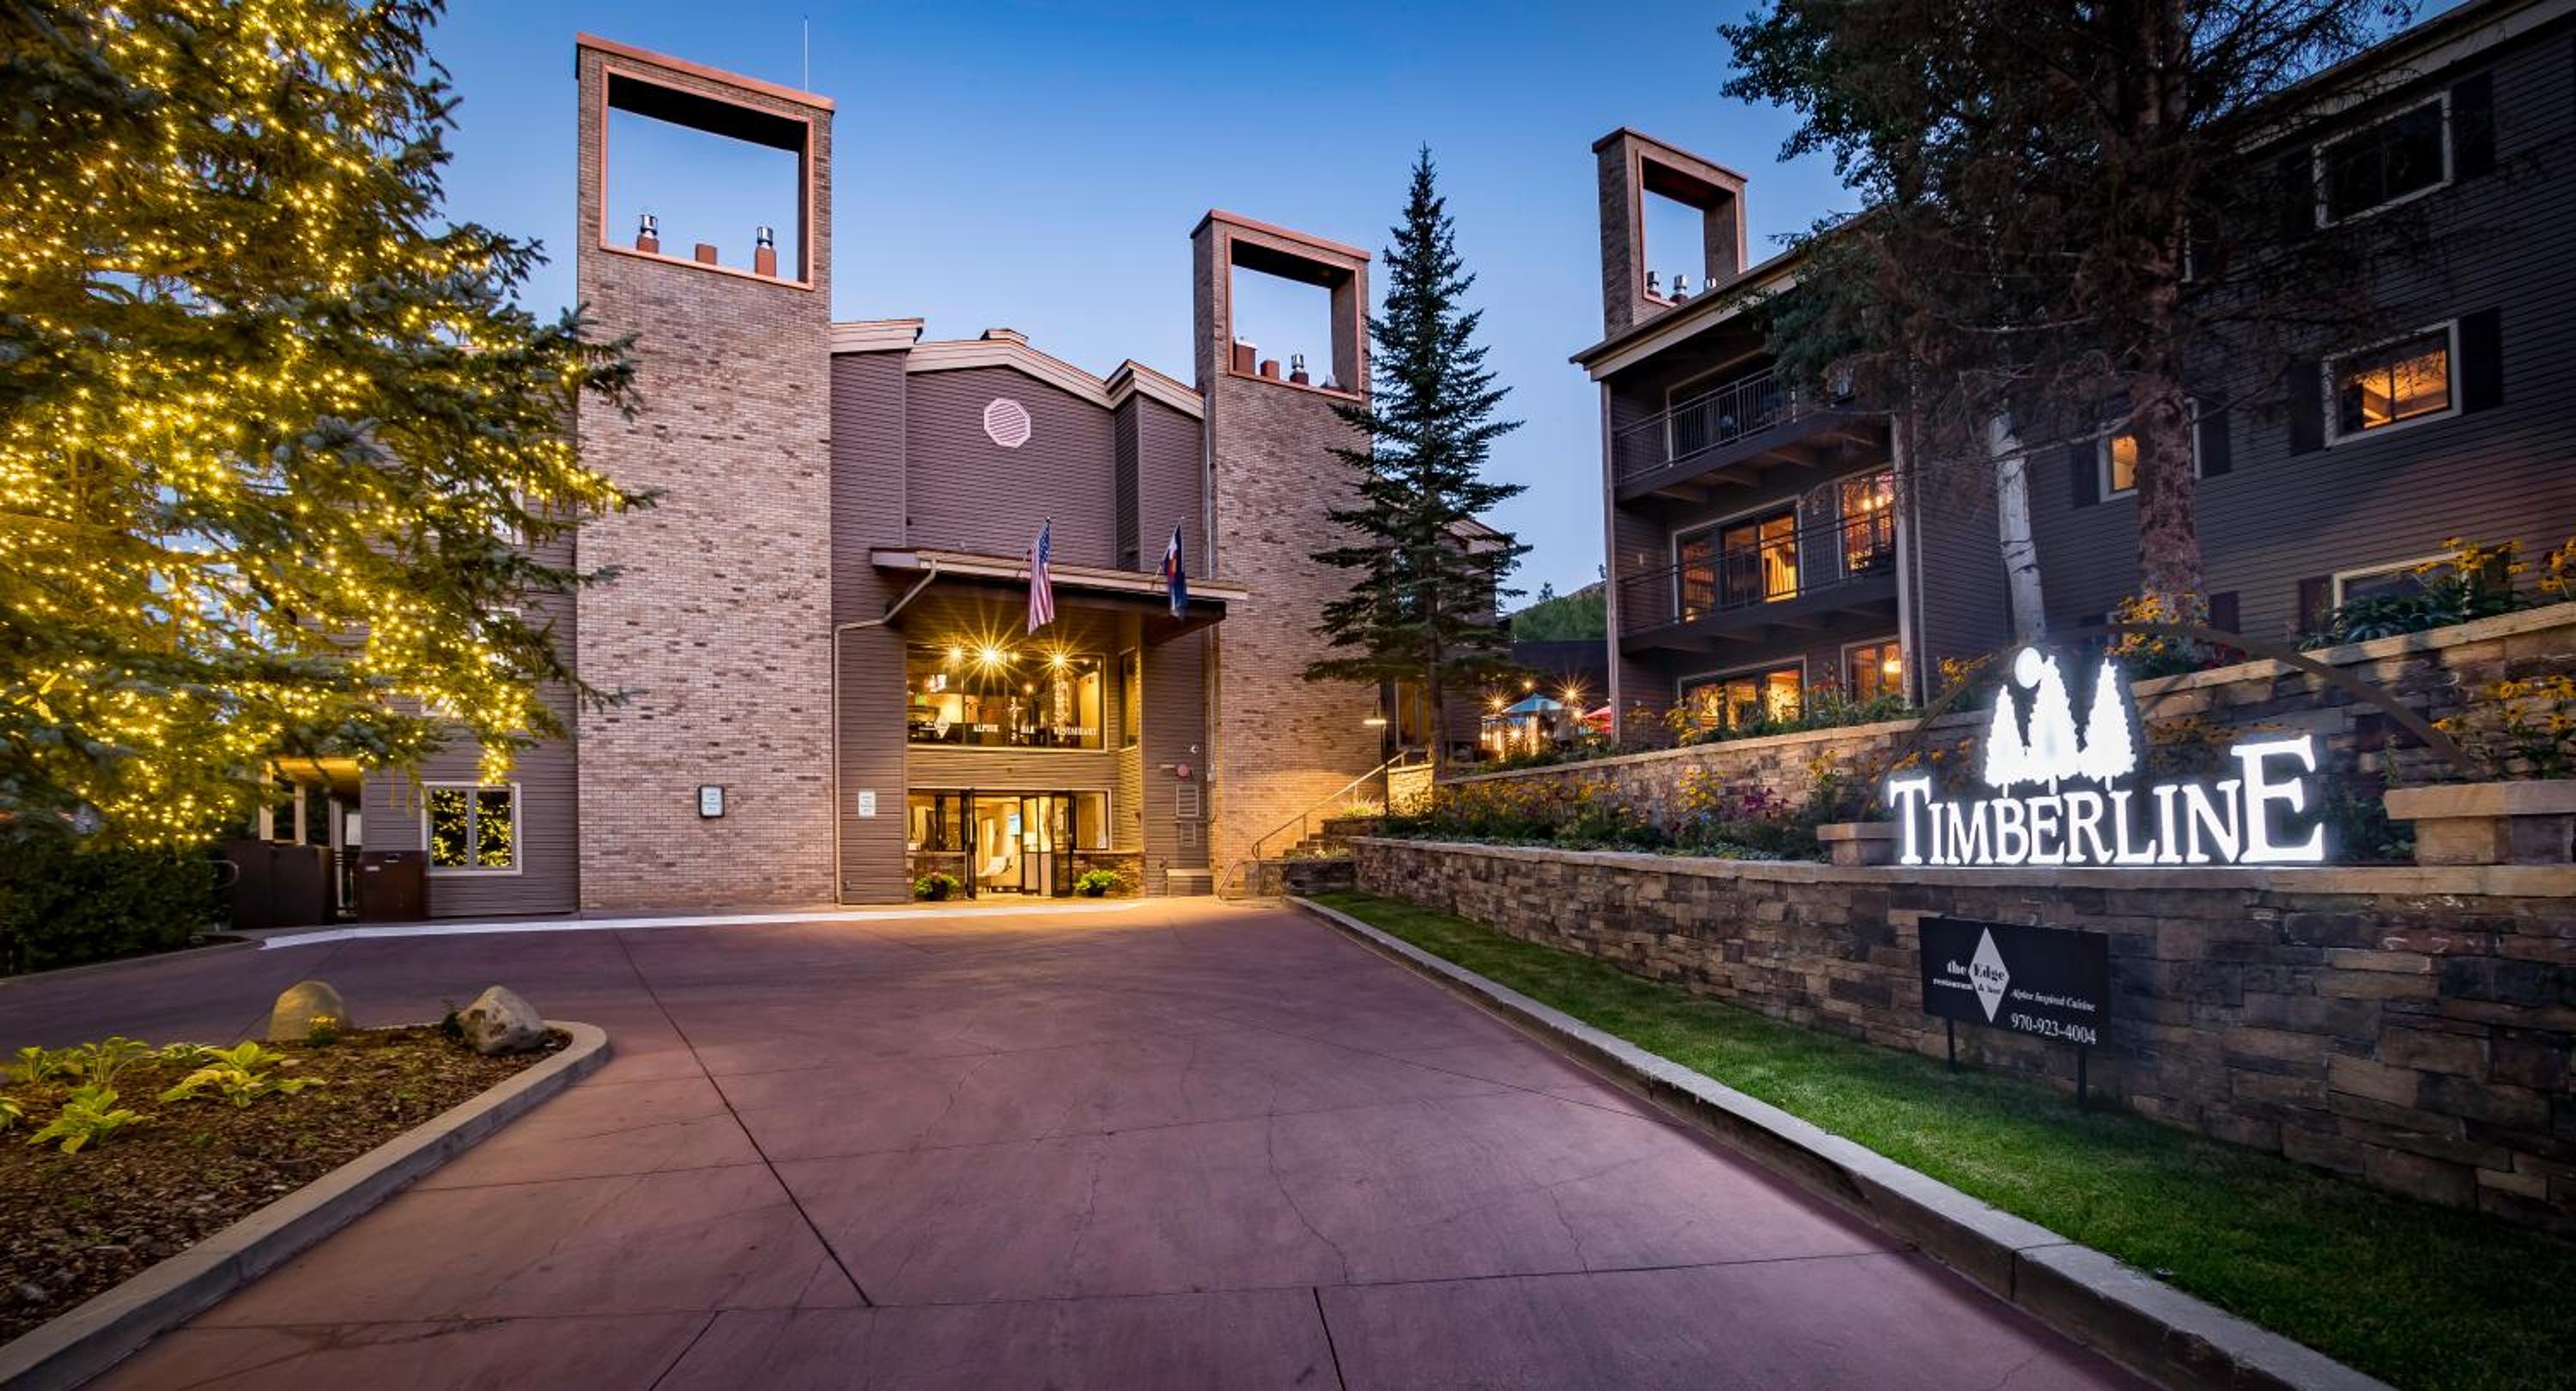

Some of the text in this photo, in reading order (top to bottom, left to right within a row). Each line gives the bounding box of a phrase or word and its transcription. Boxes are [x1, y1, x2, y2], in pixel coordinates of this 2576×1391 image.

[1890, 735, 2323, 865] TIMBERLINE
[1947, 960, 2005, 981] the Edge
[2066, 997, 2096, 1012] Cuisine
[2011, 1013, 2096, 1044] 970-923-4004
